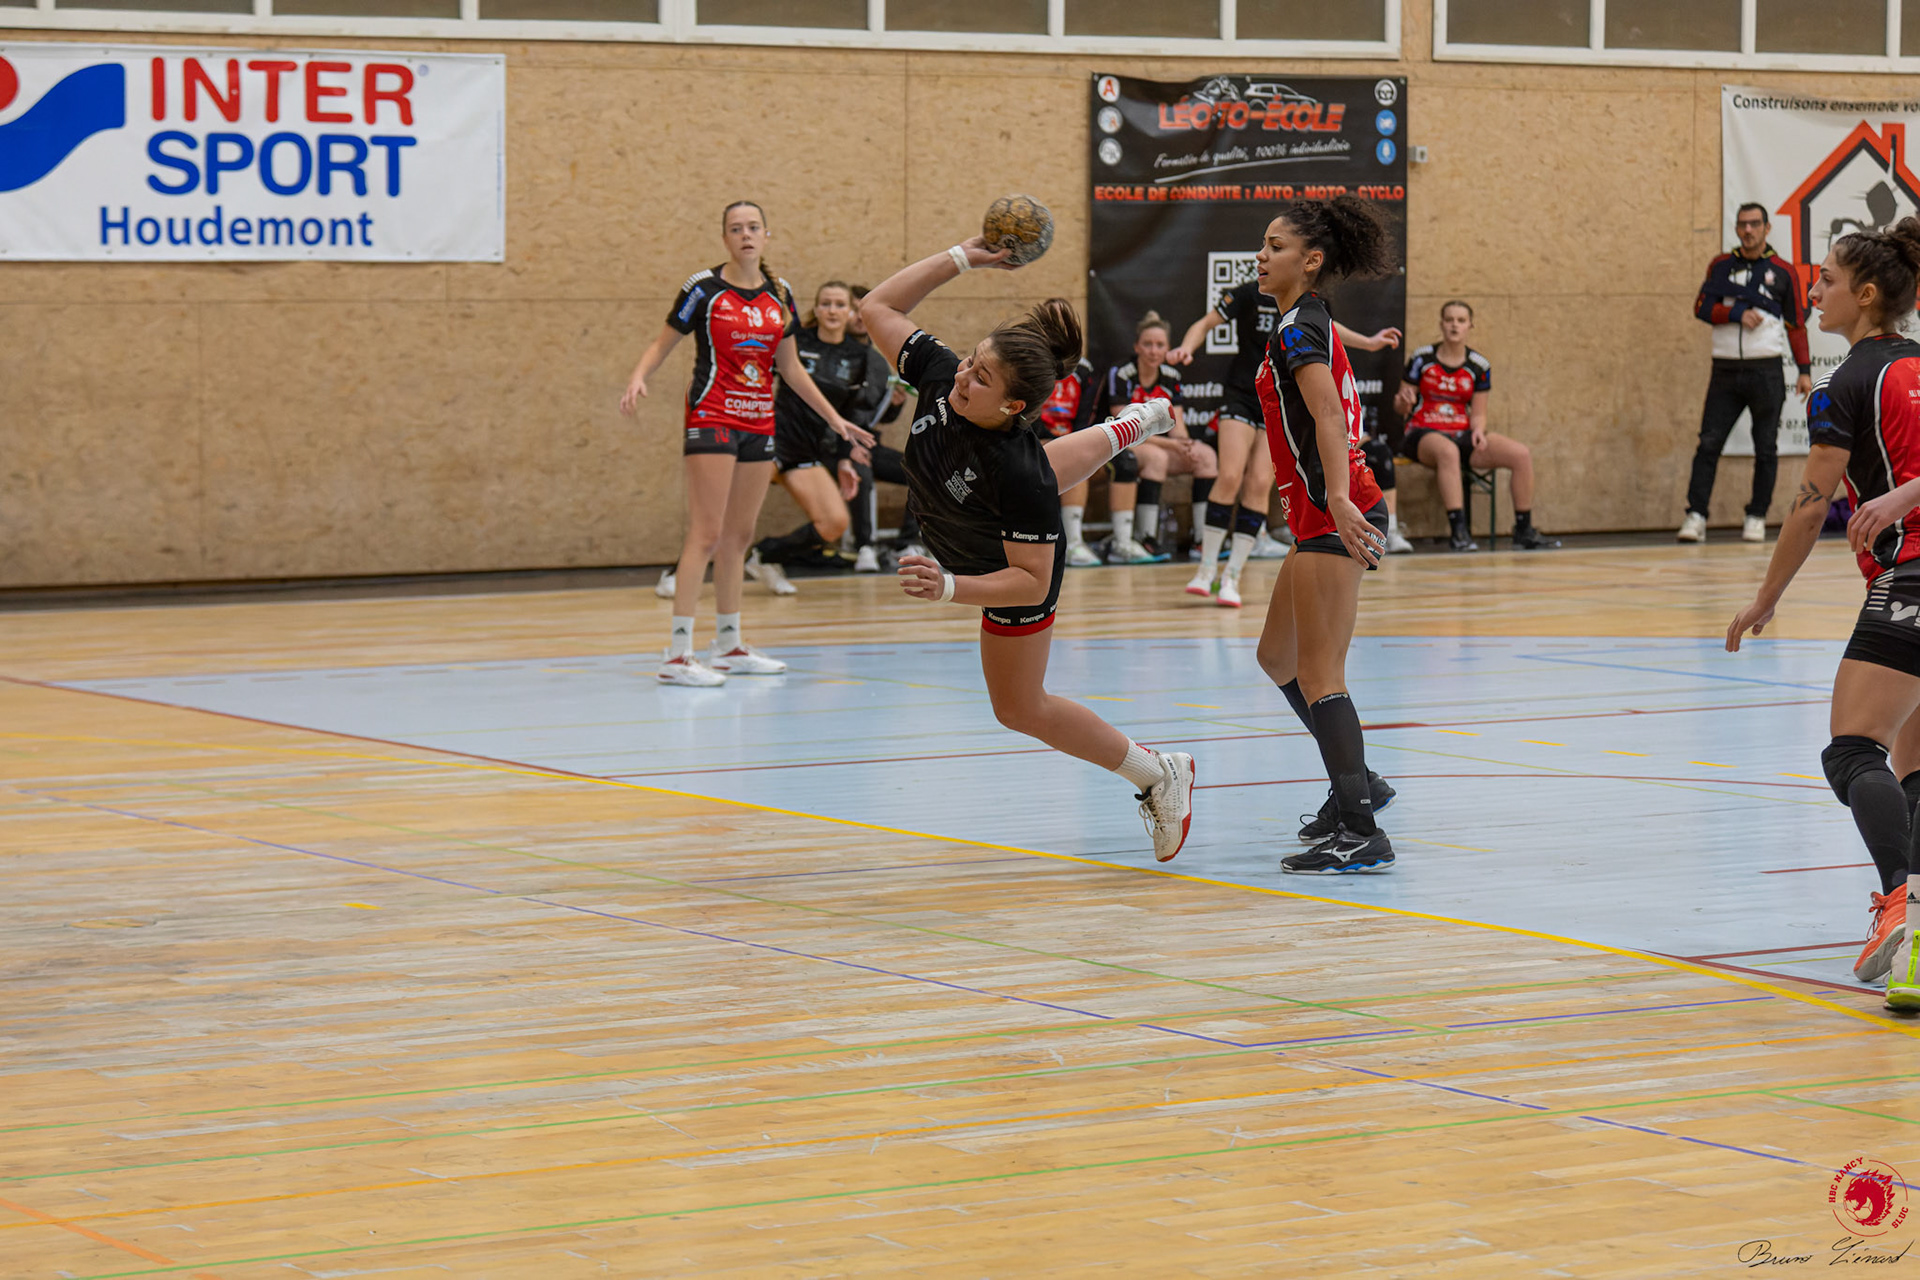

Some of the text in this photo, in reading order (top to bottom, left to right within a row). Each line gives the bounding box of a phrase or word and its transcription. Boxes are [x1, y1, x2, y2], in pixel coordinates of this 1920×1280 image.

[151, 56, 415, 125] INTER
[1733, 94, 1826, 111] Construisons
[146, 131, 416, 197] SPORT
[1094, 185, 1145, 201] ECOLE
[1147, 186, 1168, 201] DE
[1169, 185, 1242, 200] CONDUITE
[1253, 185, 1294, 200] AUTO
[1304, 185, 1347, 200] MOTO
[1357, 185, 1405, 200] CYCLO
[100, 206, 374, 247] Houdemont
[1255, 313, 1274, 332] 33
[935, 396, 949, 427] Kempa
[911, 414, 937, 435] 6
[1012, 531, 1039, 541] Kempa
[988, 611, 1011, 624] Kempa
[1019, 612, 1045, 625] Kempa
